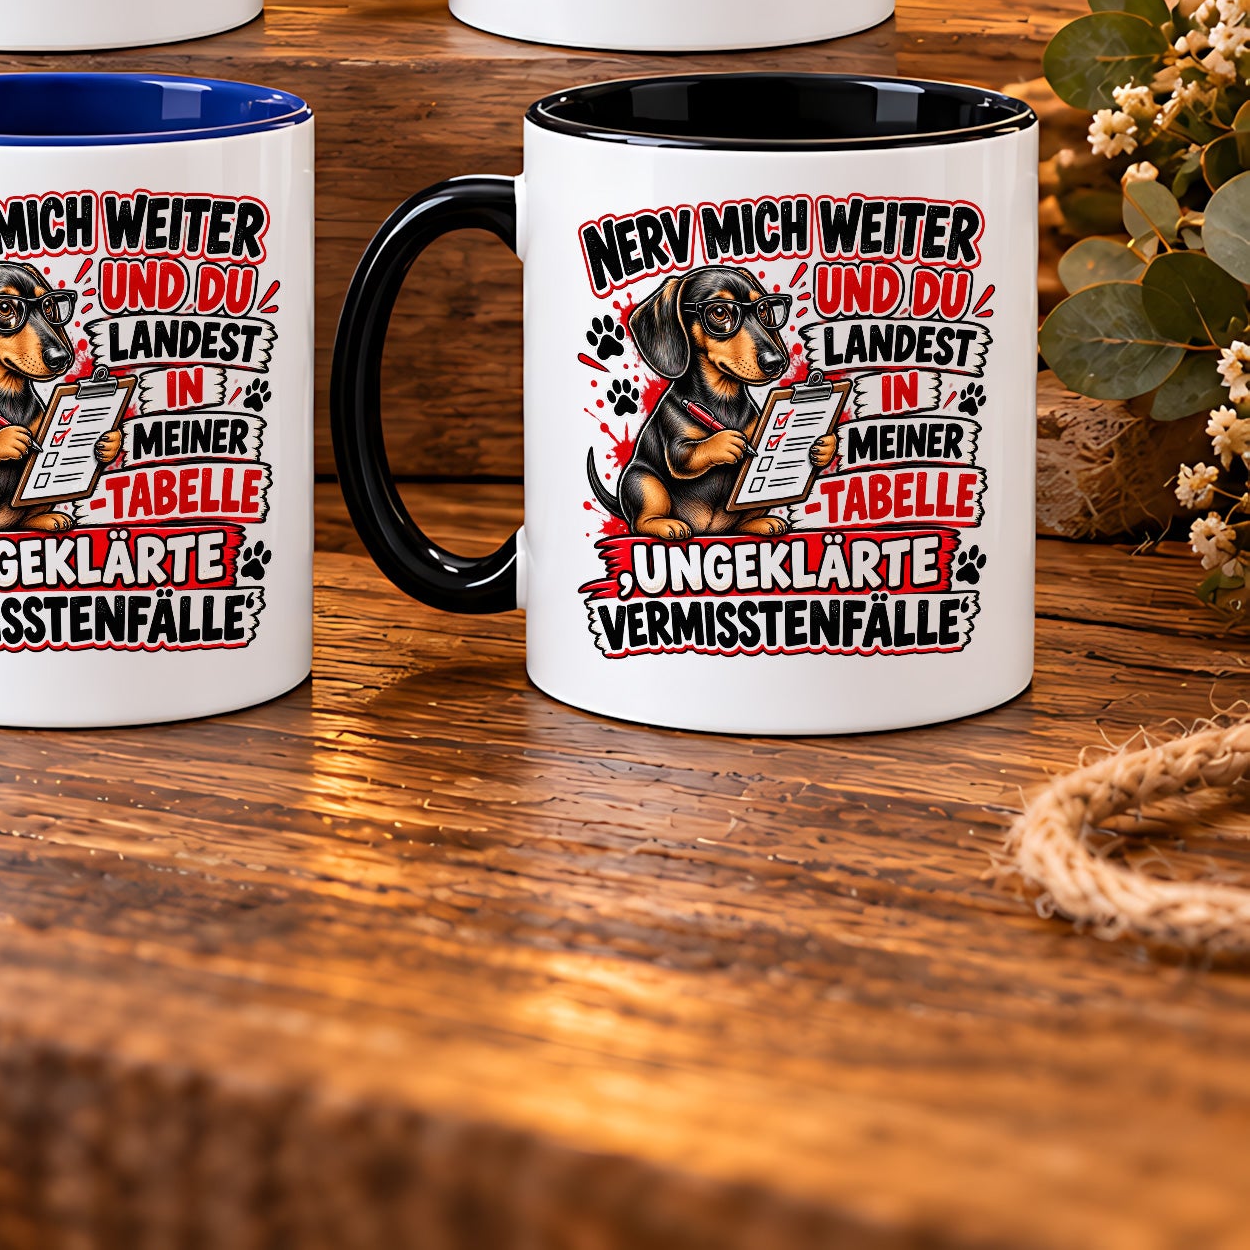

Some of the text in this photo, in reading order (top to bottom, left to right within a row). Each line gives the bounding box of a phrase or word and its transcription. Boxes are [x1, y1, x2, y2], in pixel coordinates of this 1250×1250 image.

[104, 194, 266, 255] WEITER
[584, 199, 981, 290] NERV MICH WEITER
[102, 260, 254, 311] UND DU
[817, 265, 969, 315] UND DU
[110, 322, 262, 361] LANDEST
[824, 326, 977, 365] LANDEST
[166, 370, 203, 407] IN
[881, 374, 918, 412] IN
[135, 420, 247, 457] MEINER
[850, 424, 962, 462] MEINER
